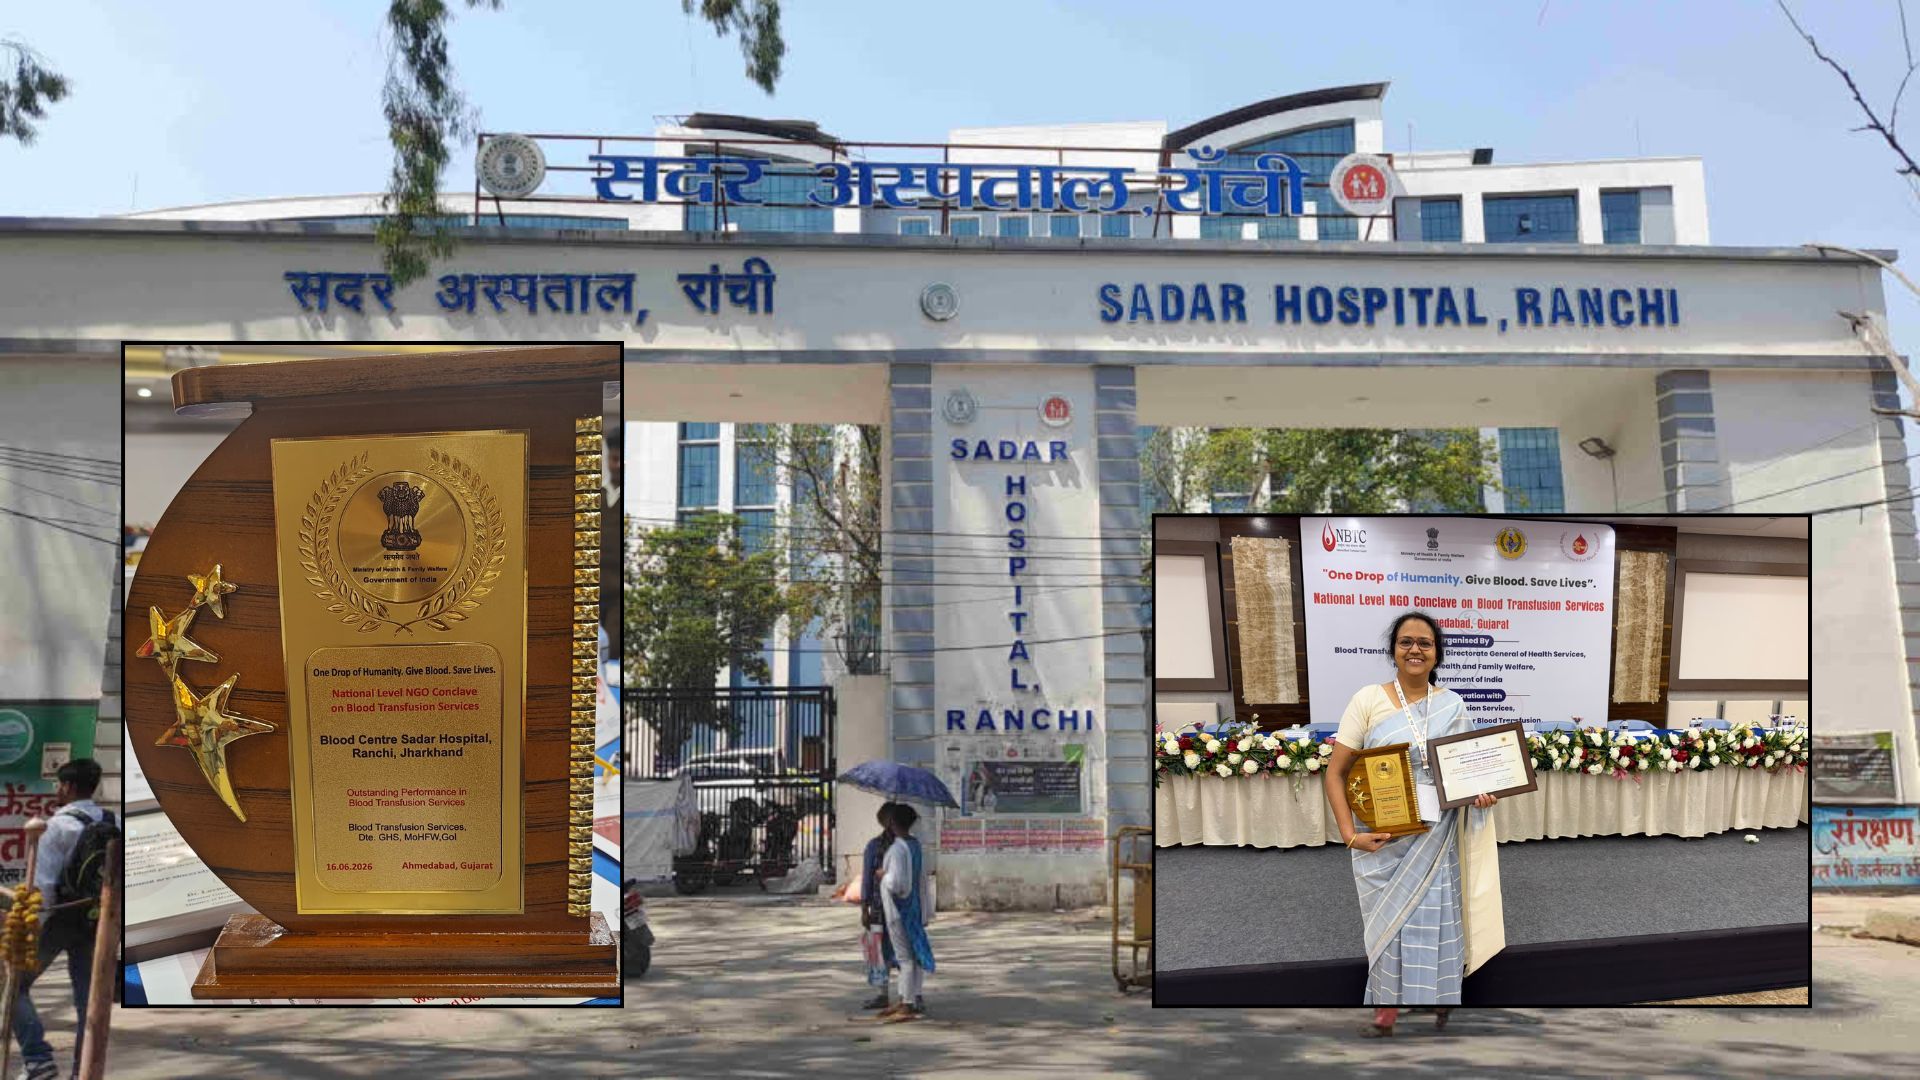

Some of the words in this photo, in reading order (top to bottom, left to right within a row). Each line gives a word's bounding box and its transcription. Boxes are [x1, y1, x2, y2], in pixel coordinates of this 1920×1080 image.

[588, 153, 773, 204] सदर
[284, 270, 396, 314] सदर
[435, 271, 650, 325] अस्पताल,
[678, 256, 776, 314] रांची
[1099, 283, 1248, 324] SADAR
[1517, 287, 1680, 329] RANCHI
[950, 438, 1069, 462] SADAR
[1335, 528, 1367, 544] NBTC
[352, 566, 375, 574] Ministry
[408, 566, 426, 574] Family
[363, 576, 408, 584] Government
[1004, 474, 1040, 693] HOSPITAL,
[1355, 570, 1384, 584] Drop
[1386, 572, 1400, 583] of
[1400, 572, 1463, 587] Humanity.
[1465, 575, 1492, 586] Give
[1493, 575, 1529, 587] Blood.
[1530, 576, 1558, 588] Save
[1313, 592, 1355, 605] National
[1359, 593, 1385, 606] Level
[1389, 595, 1410, 607] NGO
[1414, 595, 1457, 609] Conclave
[1461, 600, 1473, 609] on
[1477, 598, 1503, 610] Blood
[1507, 598, 1562, 611] Transfusion
[1565, 599, 1605, 612] Services
[1477, 619, 1509, 630] Gujarat
[1443, 636, 1479, 646] rganised
[1479, 637, 1490, 646] By
[1334, 646, 1358, 654] Blood
[1445, 650, 1488, 658] Directorate
[1489, 650, 1519, 658] General
[1519, 650, 1528, 658] of
[1528, 650, 1552, 659] Health
[1553, 651, 1586, 660] Services,
[313, 668, 329, 677] One
[331, 668, 350, 678] Drop
[353, 667, 361, 676] of
[363, 666, 404, 678] Humanity.
[405, 666, 423, 676] Give
[425, 665, 451, 676] Blood.
[453, 665, 472, 675] Save
[474, 665, 496, 674] Lives.
[1477, 663, 1504, 672] Family
[1505, 663, 1536, 672] Welfare,
[1436, 675, 1475, 683] vernment
[1475, 675, 1484, 683] of
[332, 688, 375, 699] National
[377, 688, 403, 697] Level
[405, 687, 429, 697] NGO
[432, 687, 478, 697] Conclave
[1486, 692, 1503, 700] with
[331, 705, 344, 713] on
[346, 703, 375, 713] Blood
[378, 702, 435, 712] Transfusion
[438, 702, 480, 711] Services
[1482, 705, 1515, 713] Services,
[946, 708, 1093, 732] RANCHI
[320, 735, 355, 745] Blood
[358, 734, 398, 745] Centre
[401, 734, 435, 744] Sadar
[439, 733, 492, 746] Hospital,
[352, 747, 397, 759] Ranchi,
[400, 747, 463, 758] Jharkhand
[346, 788, 399, 798] Outstanding
[401, 787, 456, 797] Performance
[458, 787, 467, 796] in
[349, 798, 374, 807] Blood
[376, 798, 426, 807] Transfusion
[428, 798, 466, 807] Services
[348, 823, 373, 832] Blood
[375, 823, 425, 831] Transfusion
[427, 823, 467, 832] Services,
[358, 833, 376, 842] Dte.
[378, 833, 402, 842] GHS,
[326, 863, 373, 871] 16.06.2026
[402, 861, 458, 871] Ahmedabad,
[460, 862, 493, 872] Gujarat
